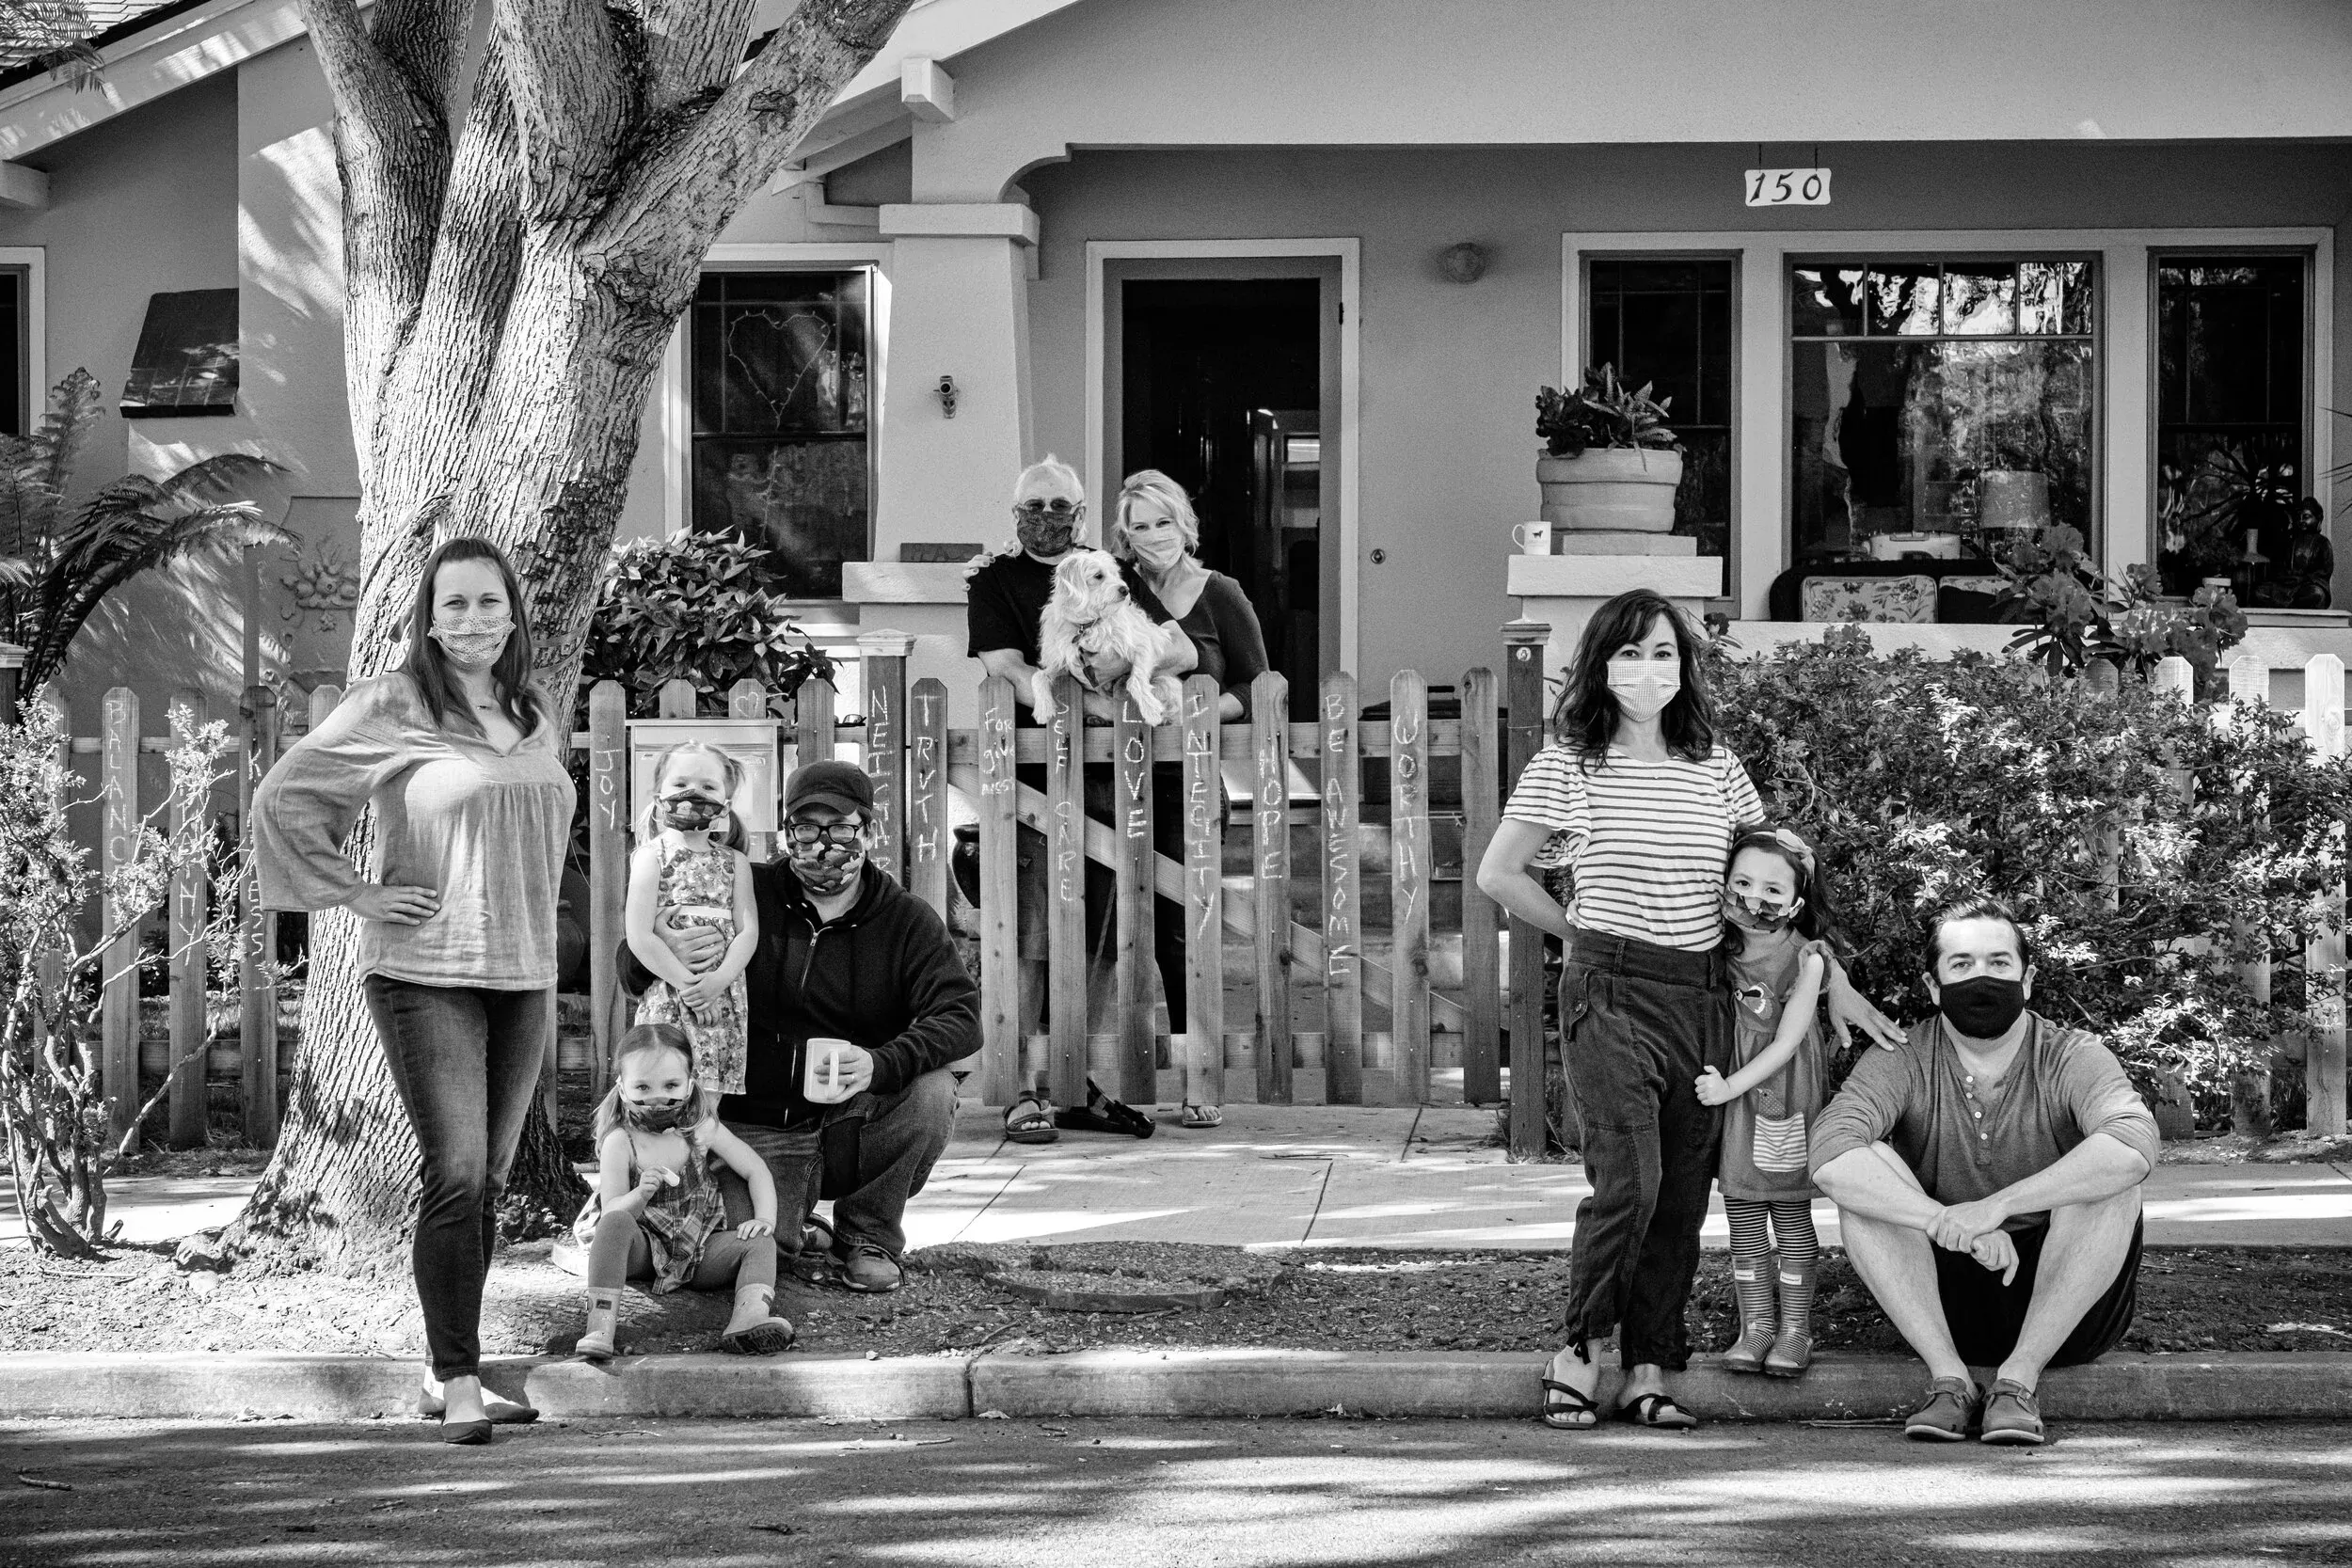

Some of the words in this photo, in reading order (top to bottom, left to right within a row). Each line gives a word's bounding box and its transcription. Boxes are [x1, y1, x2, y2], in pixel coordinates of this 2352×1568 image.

[1750, 171, 1822, 202] 150
[1053, 693, 1070, 774] SELF
[1122, 701, 1147, 838] LOVE
[1326, 694, 1344, 752] BE
[105, 701, 127, 862] BALANC
[596, 749, 622, 830] JOY
[1257, 744, 1283, 879] HOPE
[1055, 801, 1077, 901] CARE
[1326, 778, 1353, 975] AWESOME
